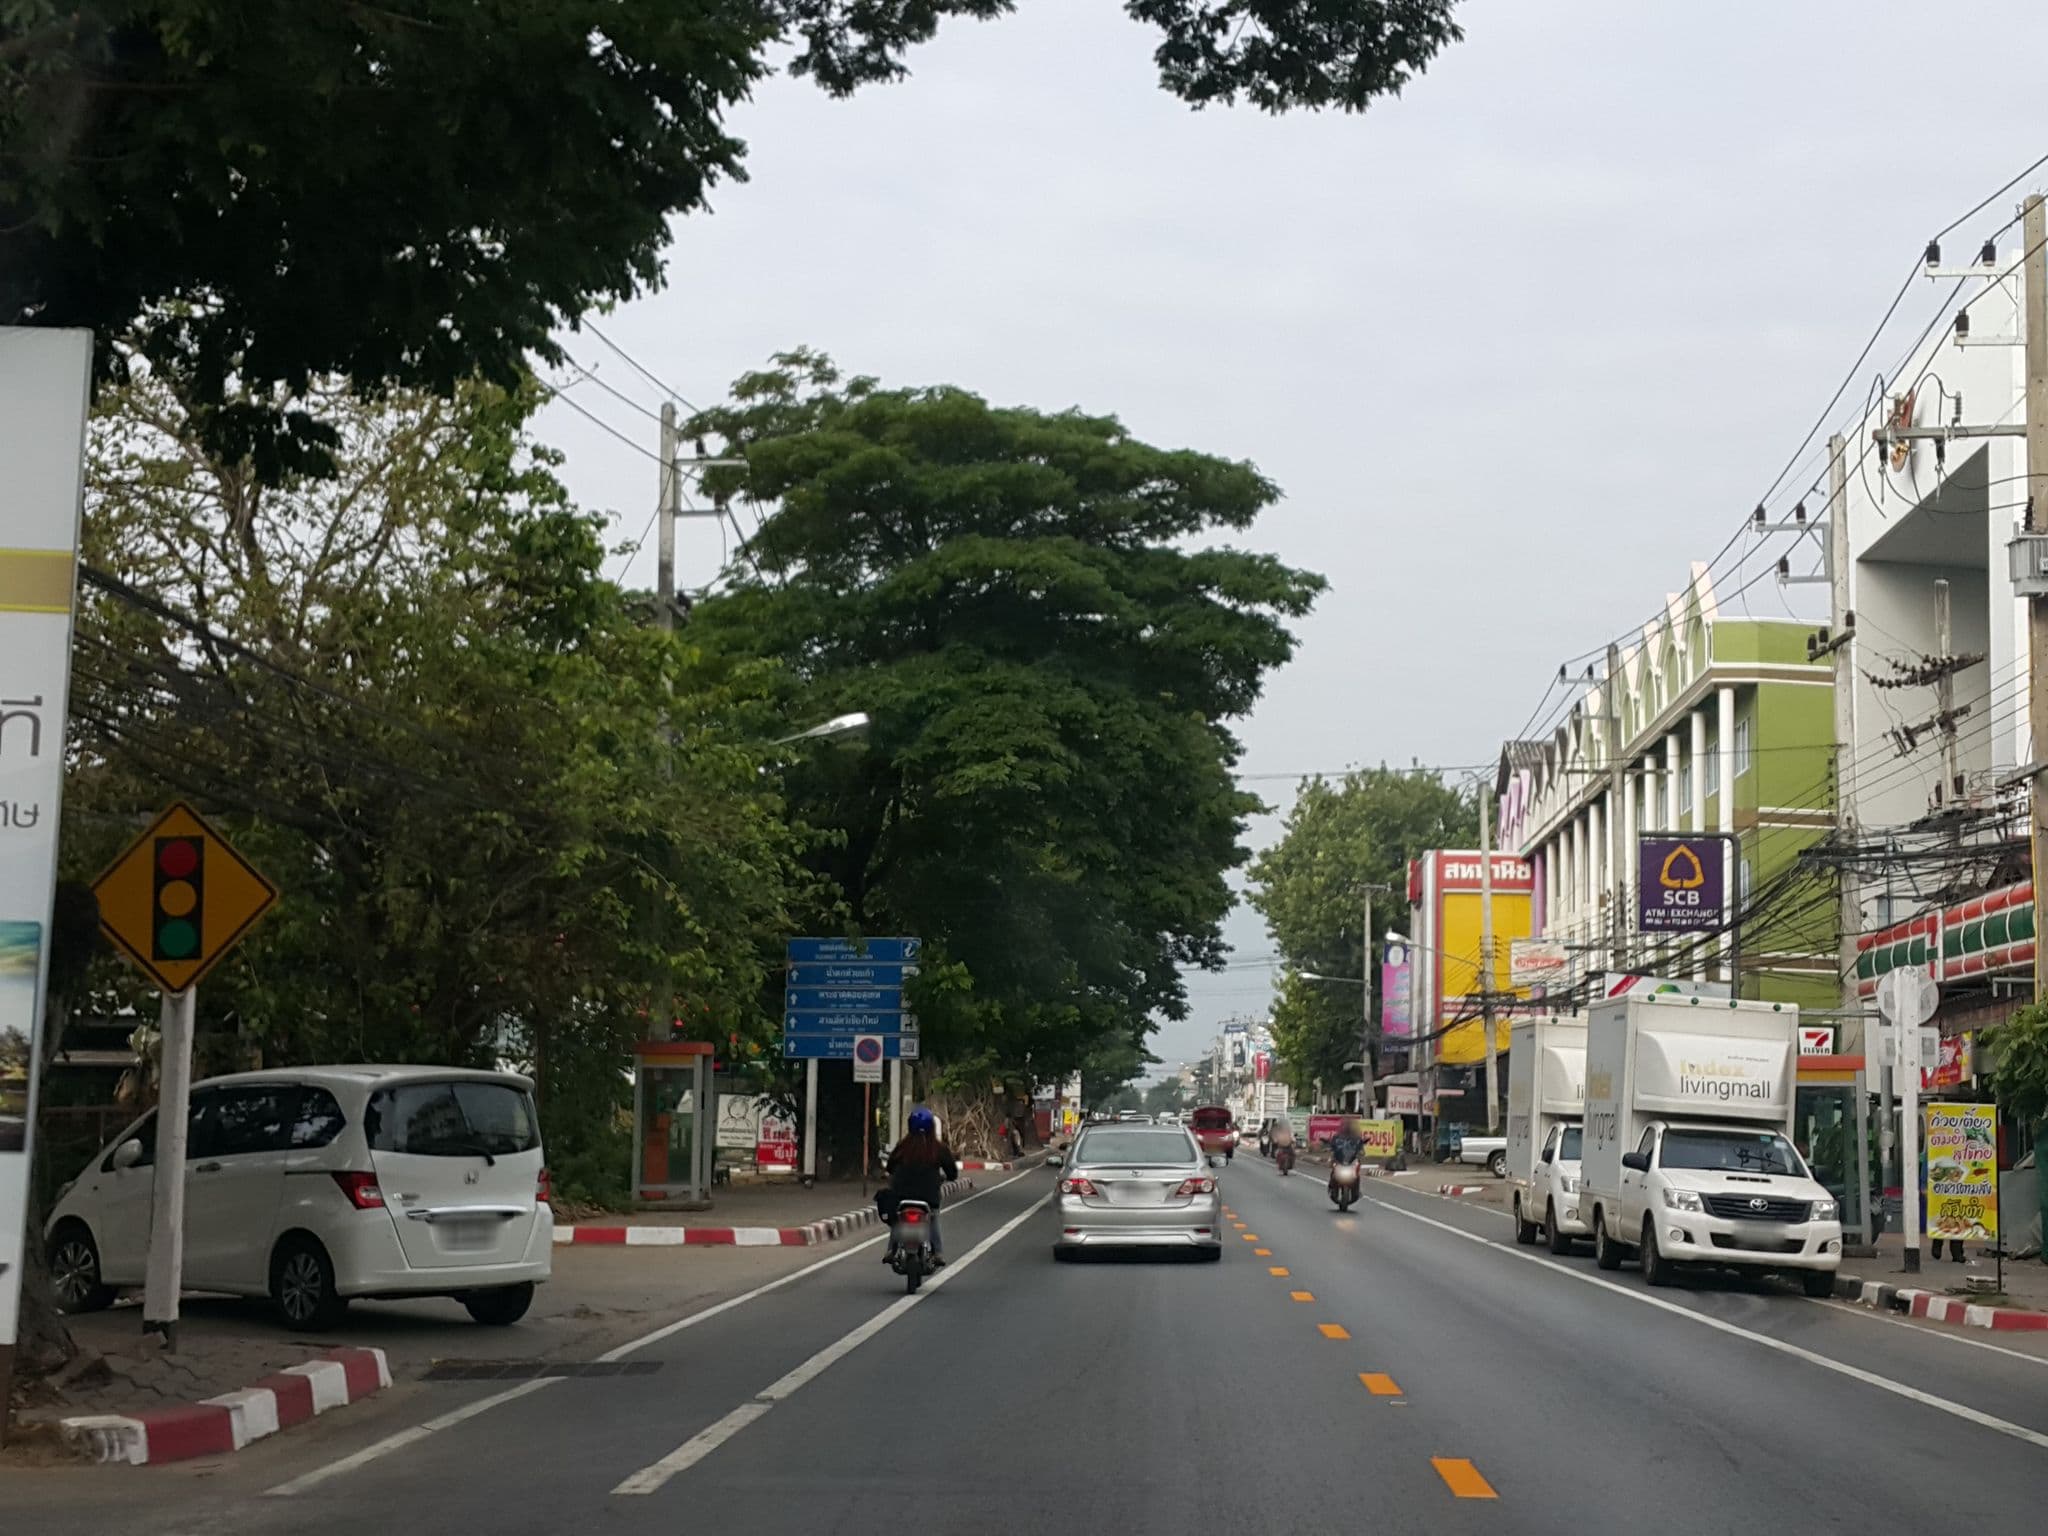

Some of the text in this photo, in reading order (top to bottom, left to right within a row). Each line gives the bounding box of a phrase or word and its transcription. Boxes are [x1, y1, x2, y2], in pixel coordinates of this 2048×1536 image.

[1663, 890, 1700, 906] SCB
[1805, 1031, 1830, 1047] 7
[1679, 1075, 1771, 1101] livingmall
